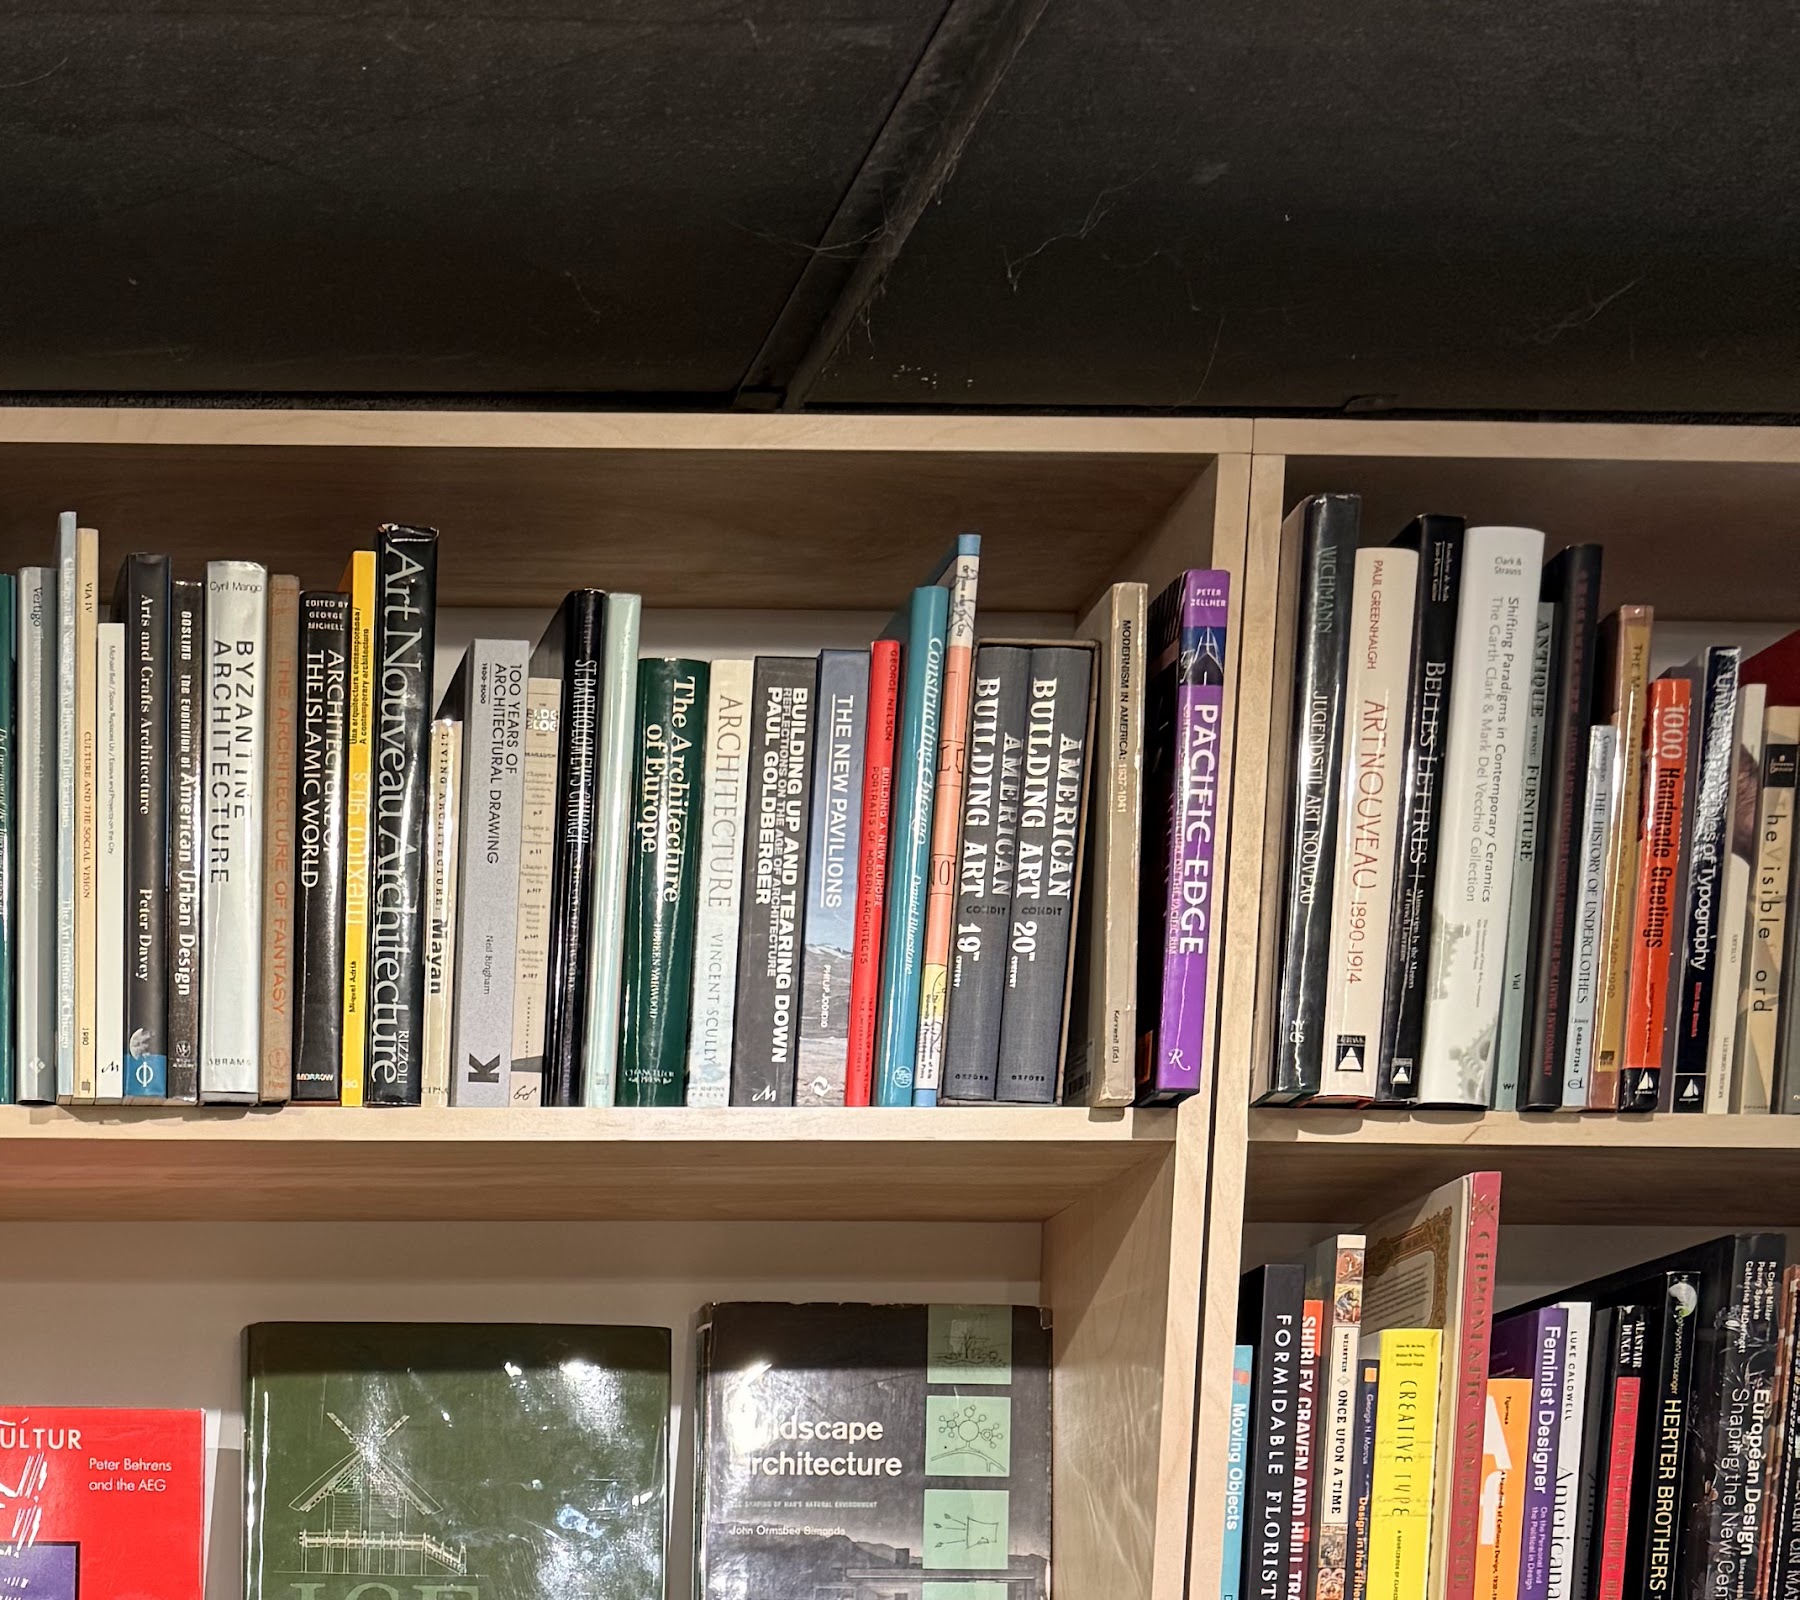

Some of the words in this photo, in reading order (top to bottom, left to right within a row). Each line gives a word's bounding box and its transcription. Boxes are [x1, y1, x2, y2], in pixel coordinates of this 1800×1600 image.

[384, 545, 423, 619] Art
[234, 640, 253, 819] BYZANTINE
[378, 627, 422, 818] Nouveau
[646, 723, 662, 750] of
[671, 676, 694, 728] The
[837, 696, 853, 737] THE
[1362, 700, 1387, 747] ART
[211, 639, 231, 882] ARCHITECTURE
[830, 744, 849, 792] NEW
[1186, 704, 1218, 843] PACIFIC
[636, 761, 663, 853] Europe
[661, 735, 692, 902] Architecture
[1352, 753, 1385, 891] NOUVEAU
[825, 797, 846, 908] PAVILIONS
[137, 888, 152, 934] Peter
[1178, 858, 1209, 955] EDGE
[1346, 901, 1366, 984] 1890-1914
[136, 933, 152, 982] Davey
[372, 828, 418, 1083] Architecture
[397, 1029, 409, 1084] RIZZOLI
[1268, 1314, 1291, 1474] FORMIDABLE
[1540, 1326, 1562, 1405] Feminist
[88, 1457, 120, 1472] Peter
[123, 1458, 172, 1472] Behrens
[89, 1478, 112, 1492] and
[116, 1478, 134, 1492] the
[138, 1479, 167, 1492] AEG
[737, 1451, 902, 1476] rchitecture
[1528, 1410, 1554, 1494] Designer
